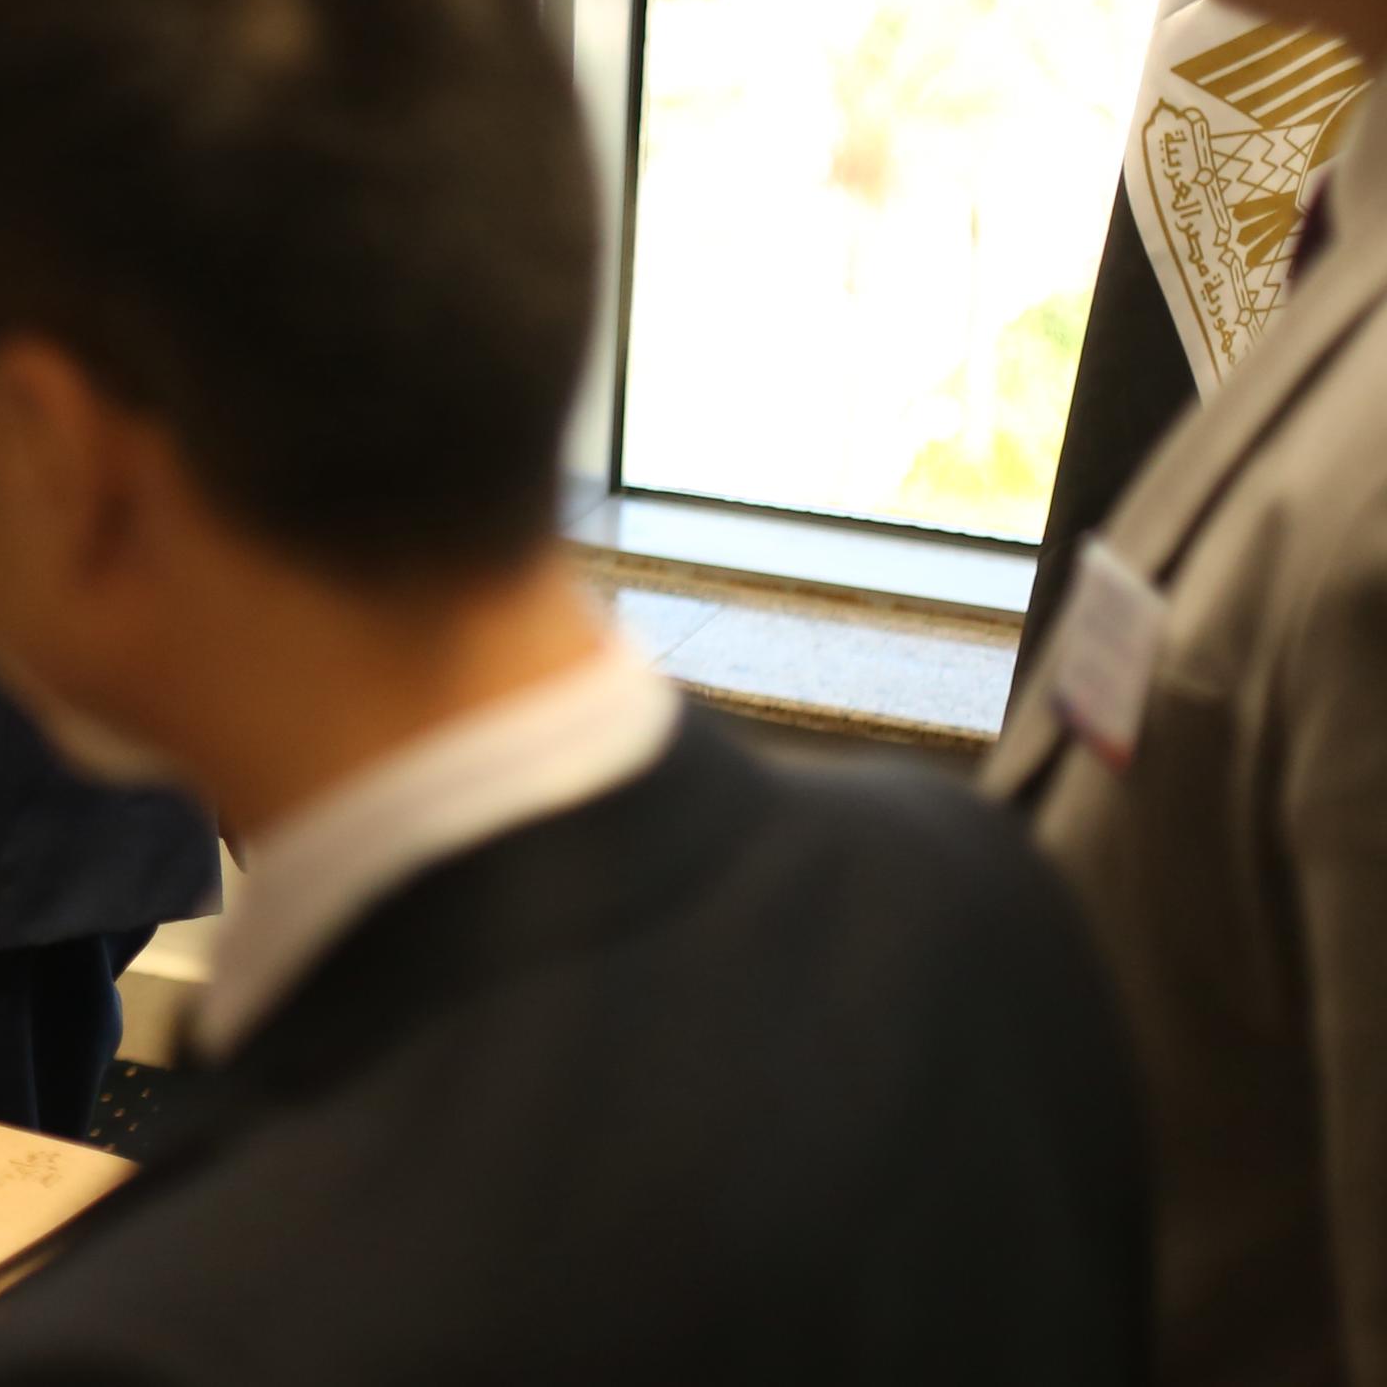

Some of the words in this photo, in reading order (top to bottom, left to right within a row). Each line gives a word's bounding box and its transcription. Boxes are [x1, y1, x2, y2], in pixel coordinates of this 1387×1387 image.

[1159, 129, 1203, 220] العربية
[1174, 218, 1211, 279] مصر
[1200, 273, 1238, 365] مهورية
